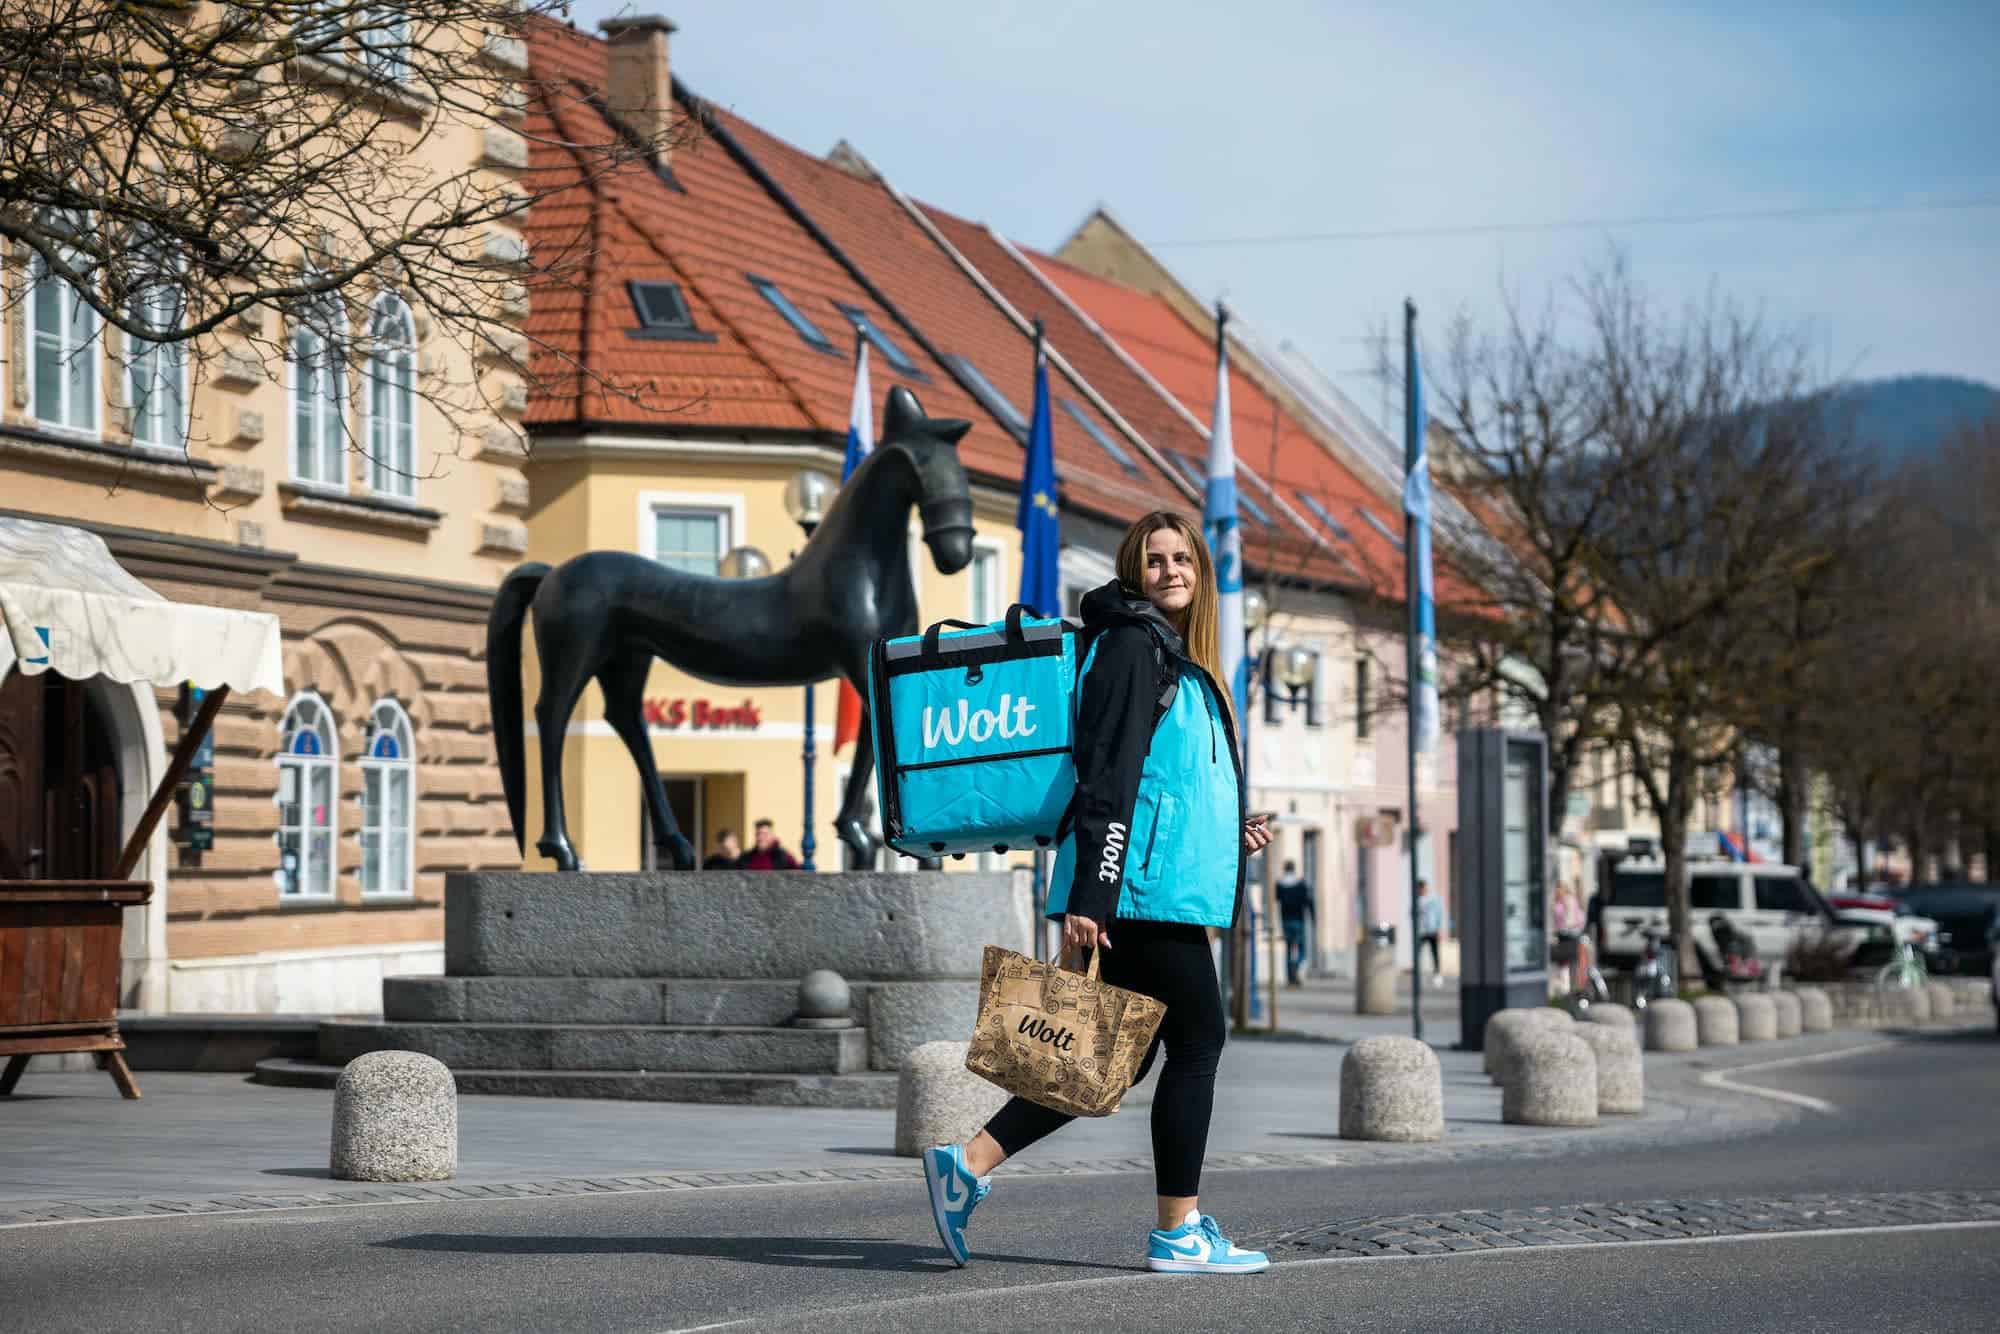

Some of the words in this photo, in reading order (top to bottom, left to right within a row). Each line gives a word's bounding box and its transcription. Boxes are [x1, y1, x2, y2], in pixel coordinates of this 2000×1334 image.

[643, 698, 686, 725] KS
[693, 697, 761, 727] Bank
[922, 694, 1038, 749] Wolt
[1099, 822, 1126, 884] Wolt
[1018, 1014, 1076, 1051] Wolt
